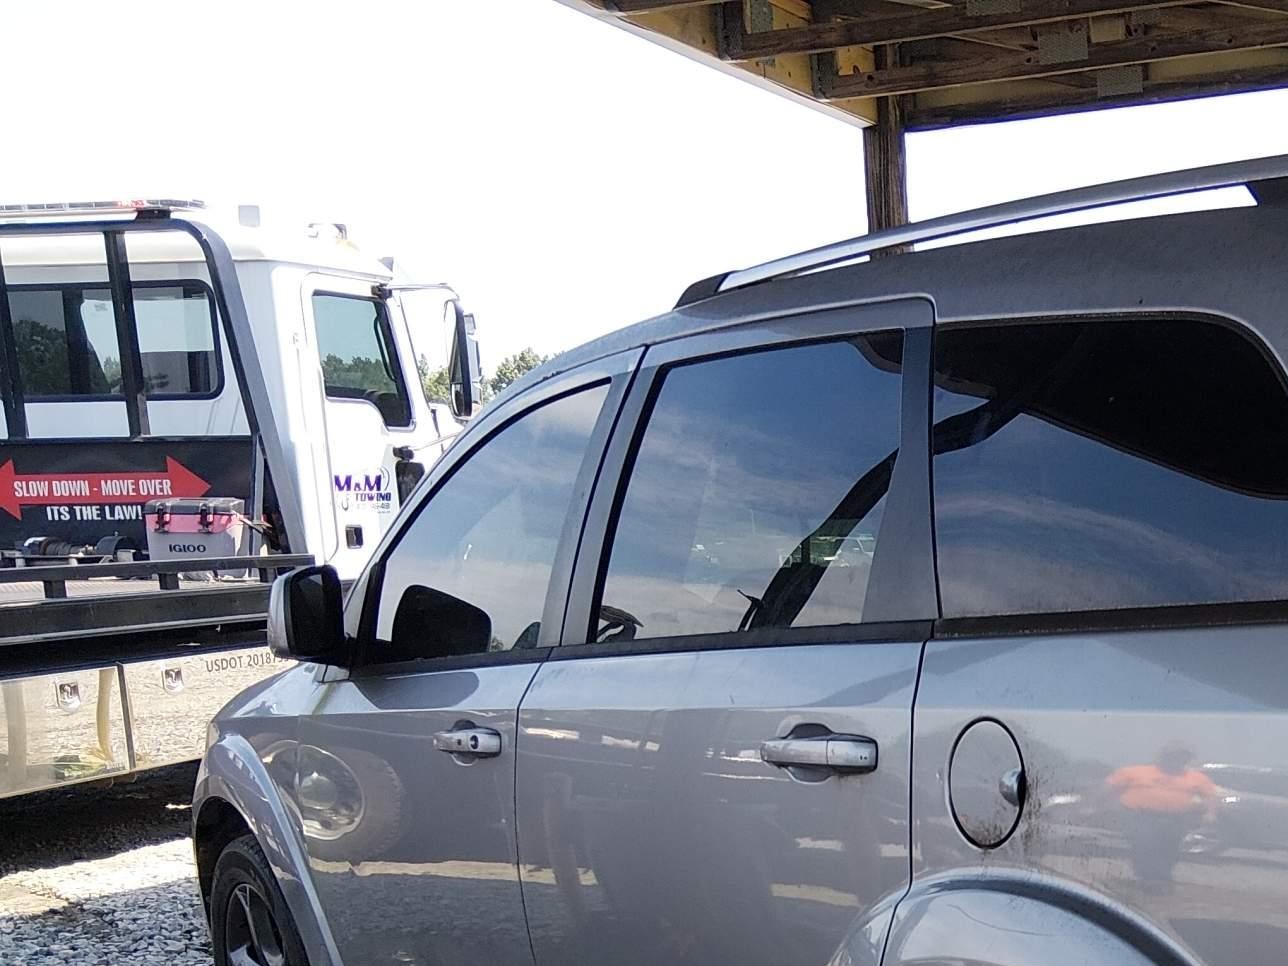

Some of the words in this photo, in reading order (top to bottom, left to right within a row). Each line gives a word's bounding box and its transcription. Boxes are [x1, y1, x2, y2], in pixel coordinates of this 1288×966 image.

[13, 480, 49, 497] SLOW
[52, 480, 90, 497] DOWN
[101, 479, 136, 496] MOVE
[139, 478, 173, 496] OVER
[46, 506, 71, 521] ITS
[75, 505, 101, 521] THE
[105, 504, 143, 520] LAW!
[168, 543, 207, 553] IGLOO
[205, 655, 243, 673] USDOT
[246, 652, 289, 667] 2018
